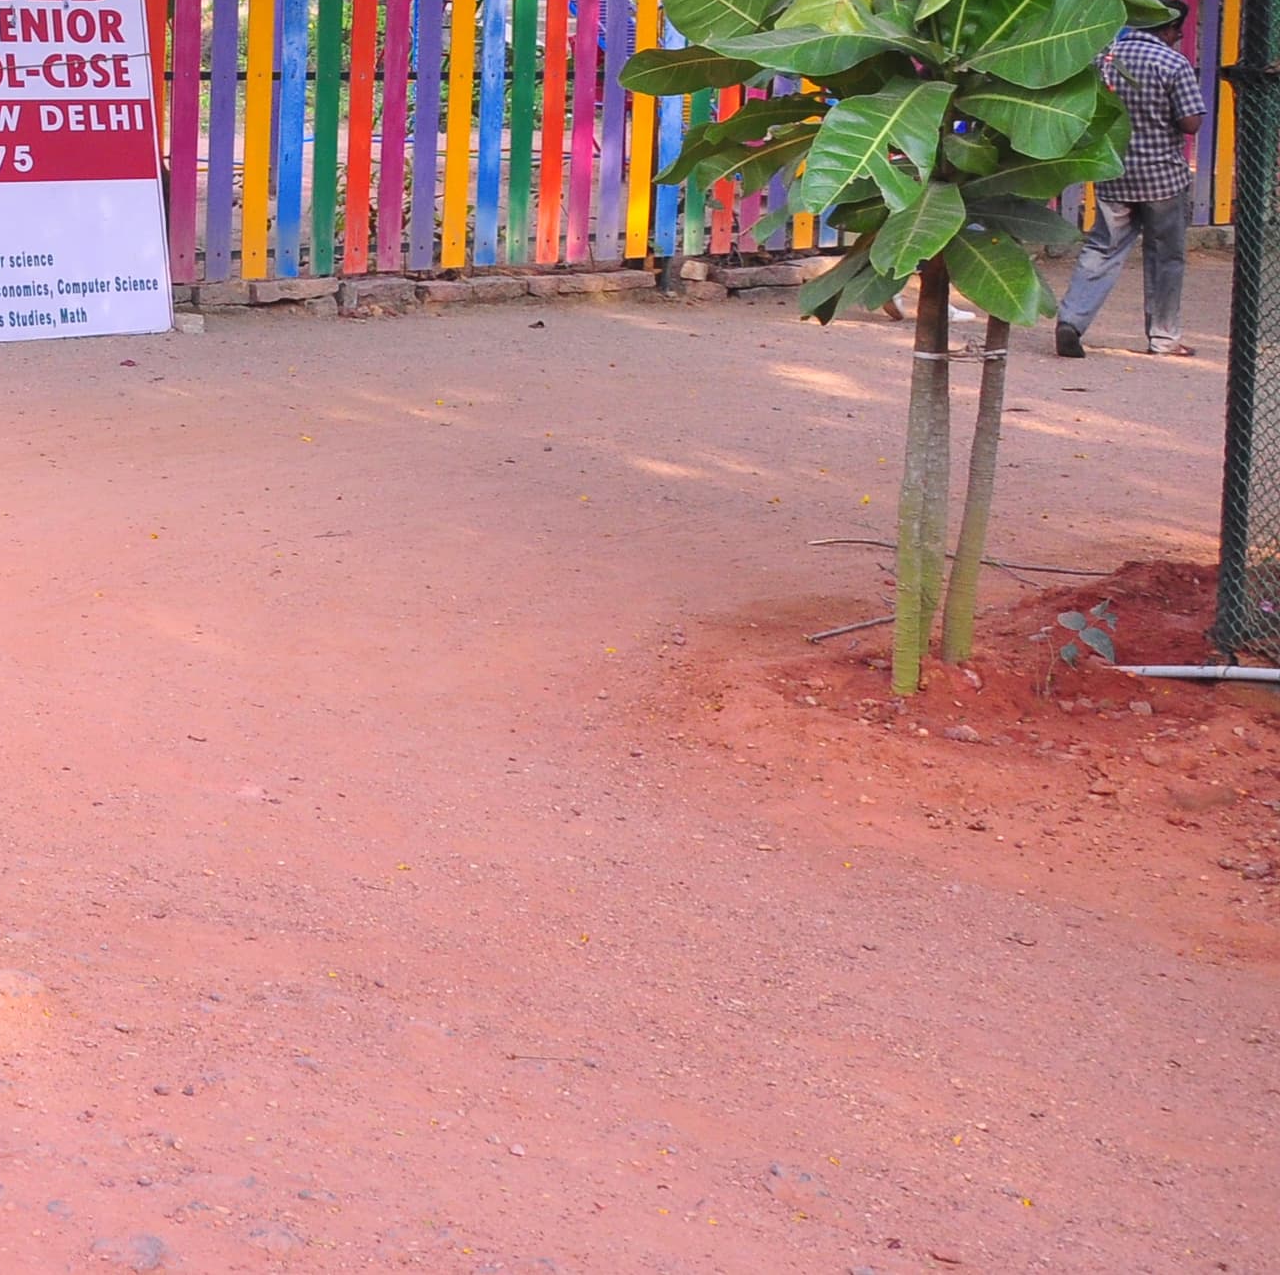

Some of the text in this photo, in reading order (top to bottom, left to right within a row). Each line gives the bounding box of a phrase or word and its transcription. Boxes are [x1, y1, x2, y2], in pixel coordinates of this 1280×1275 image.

[40, 104, 144, 132] DELHI
[9, 251, 54, 268] science
[57, 277, 111, 298] Computer
[115, 276, 158, 293] Science
[8, 308, 56, 327] Studies,
[60, 307, 88, 324] Math
